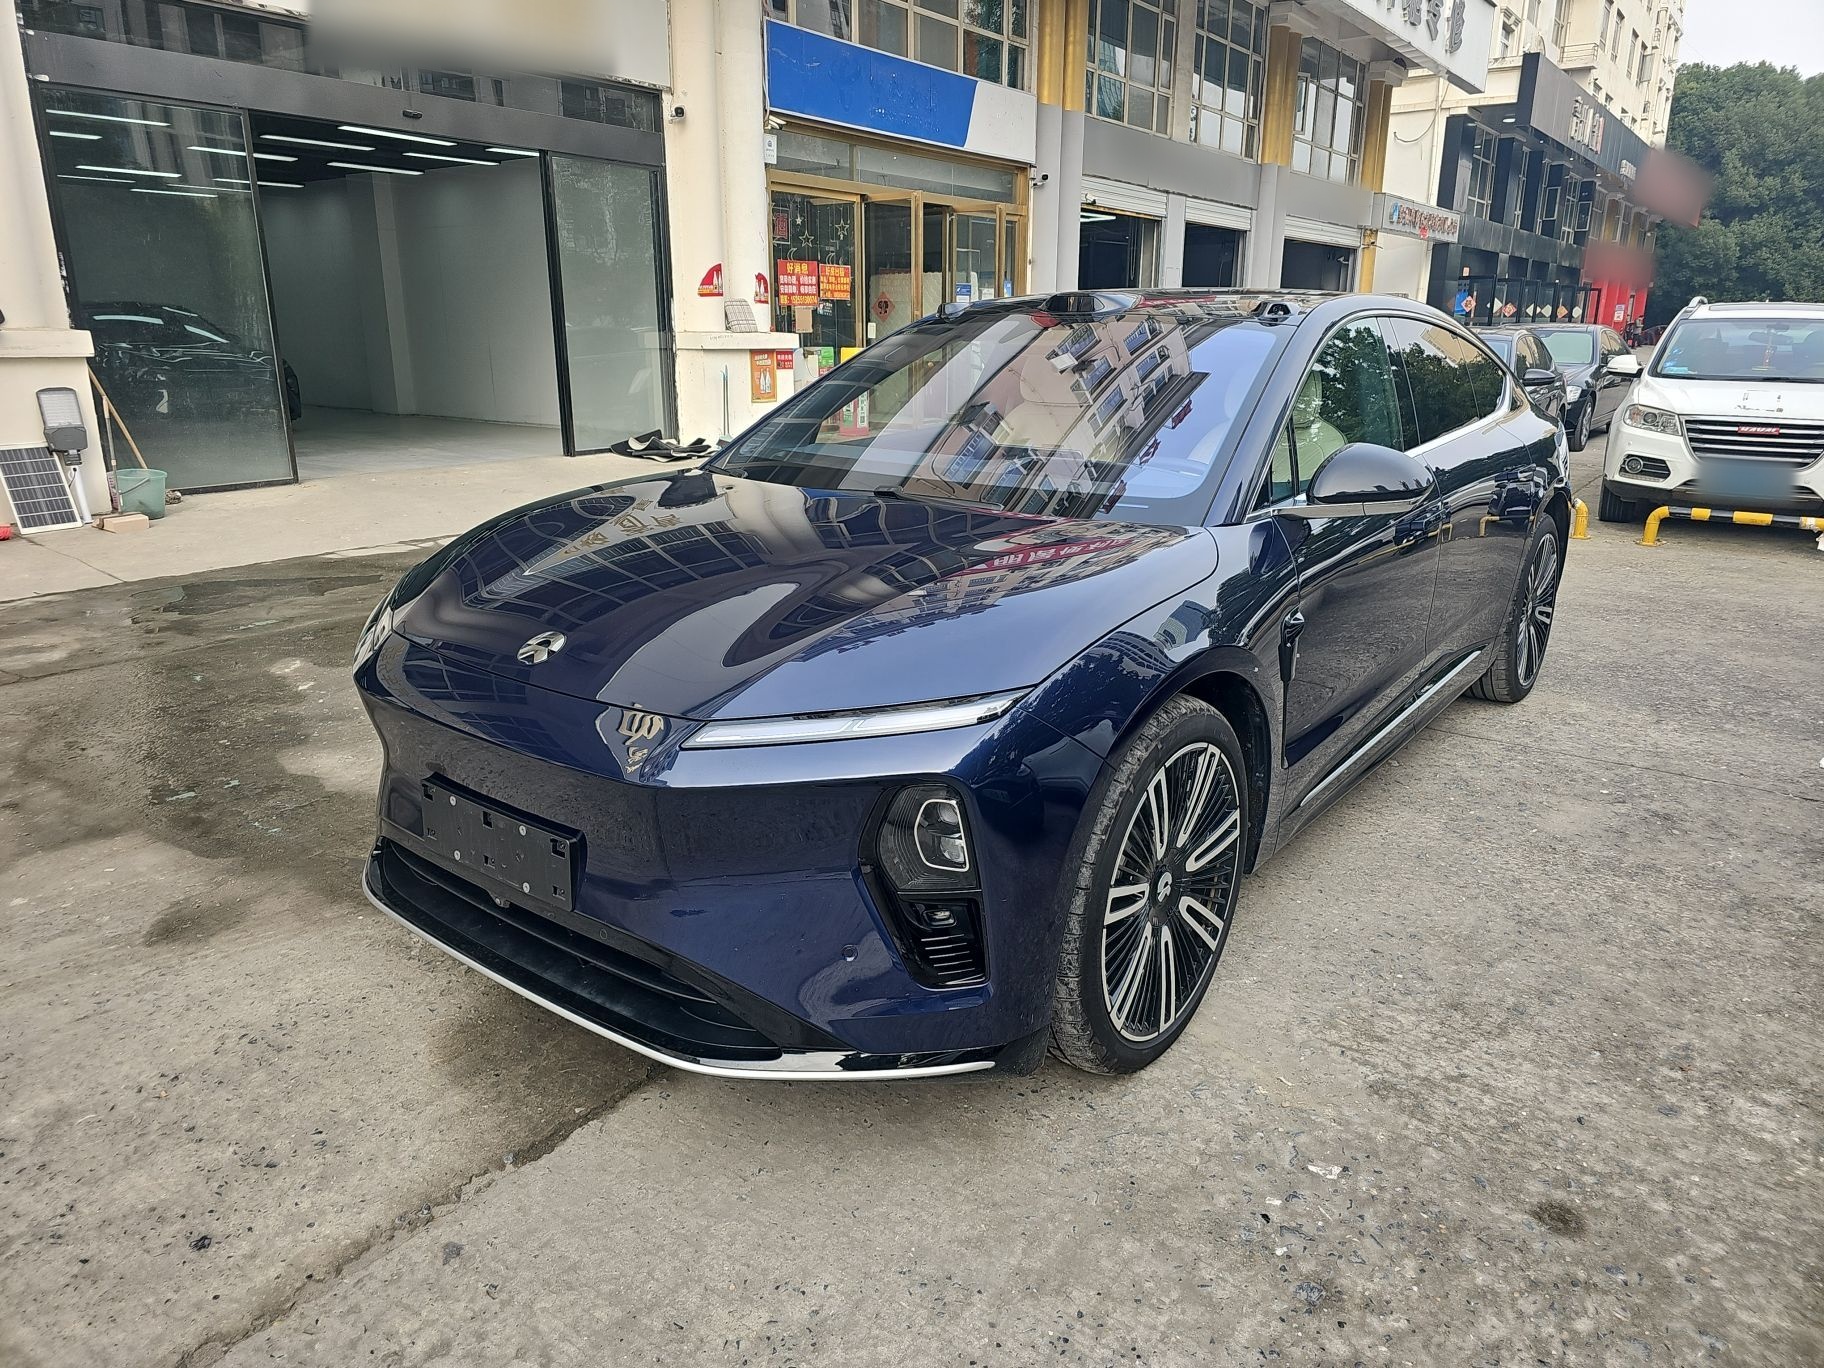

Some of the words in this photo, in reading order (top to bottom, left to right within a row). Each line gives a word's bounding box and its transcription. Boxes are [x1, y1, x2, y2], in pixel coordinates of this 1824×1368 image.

[787, 262, 809, 274] 好消息
[1738, 426, 1778, 434] HAVAL
